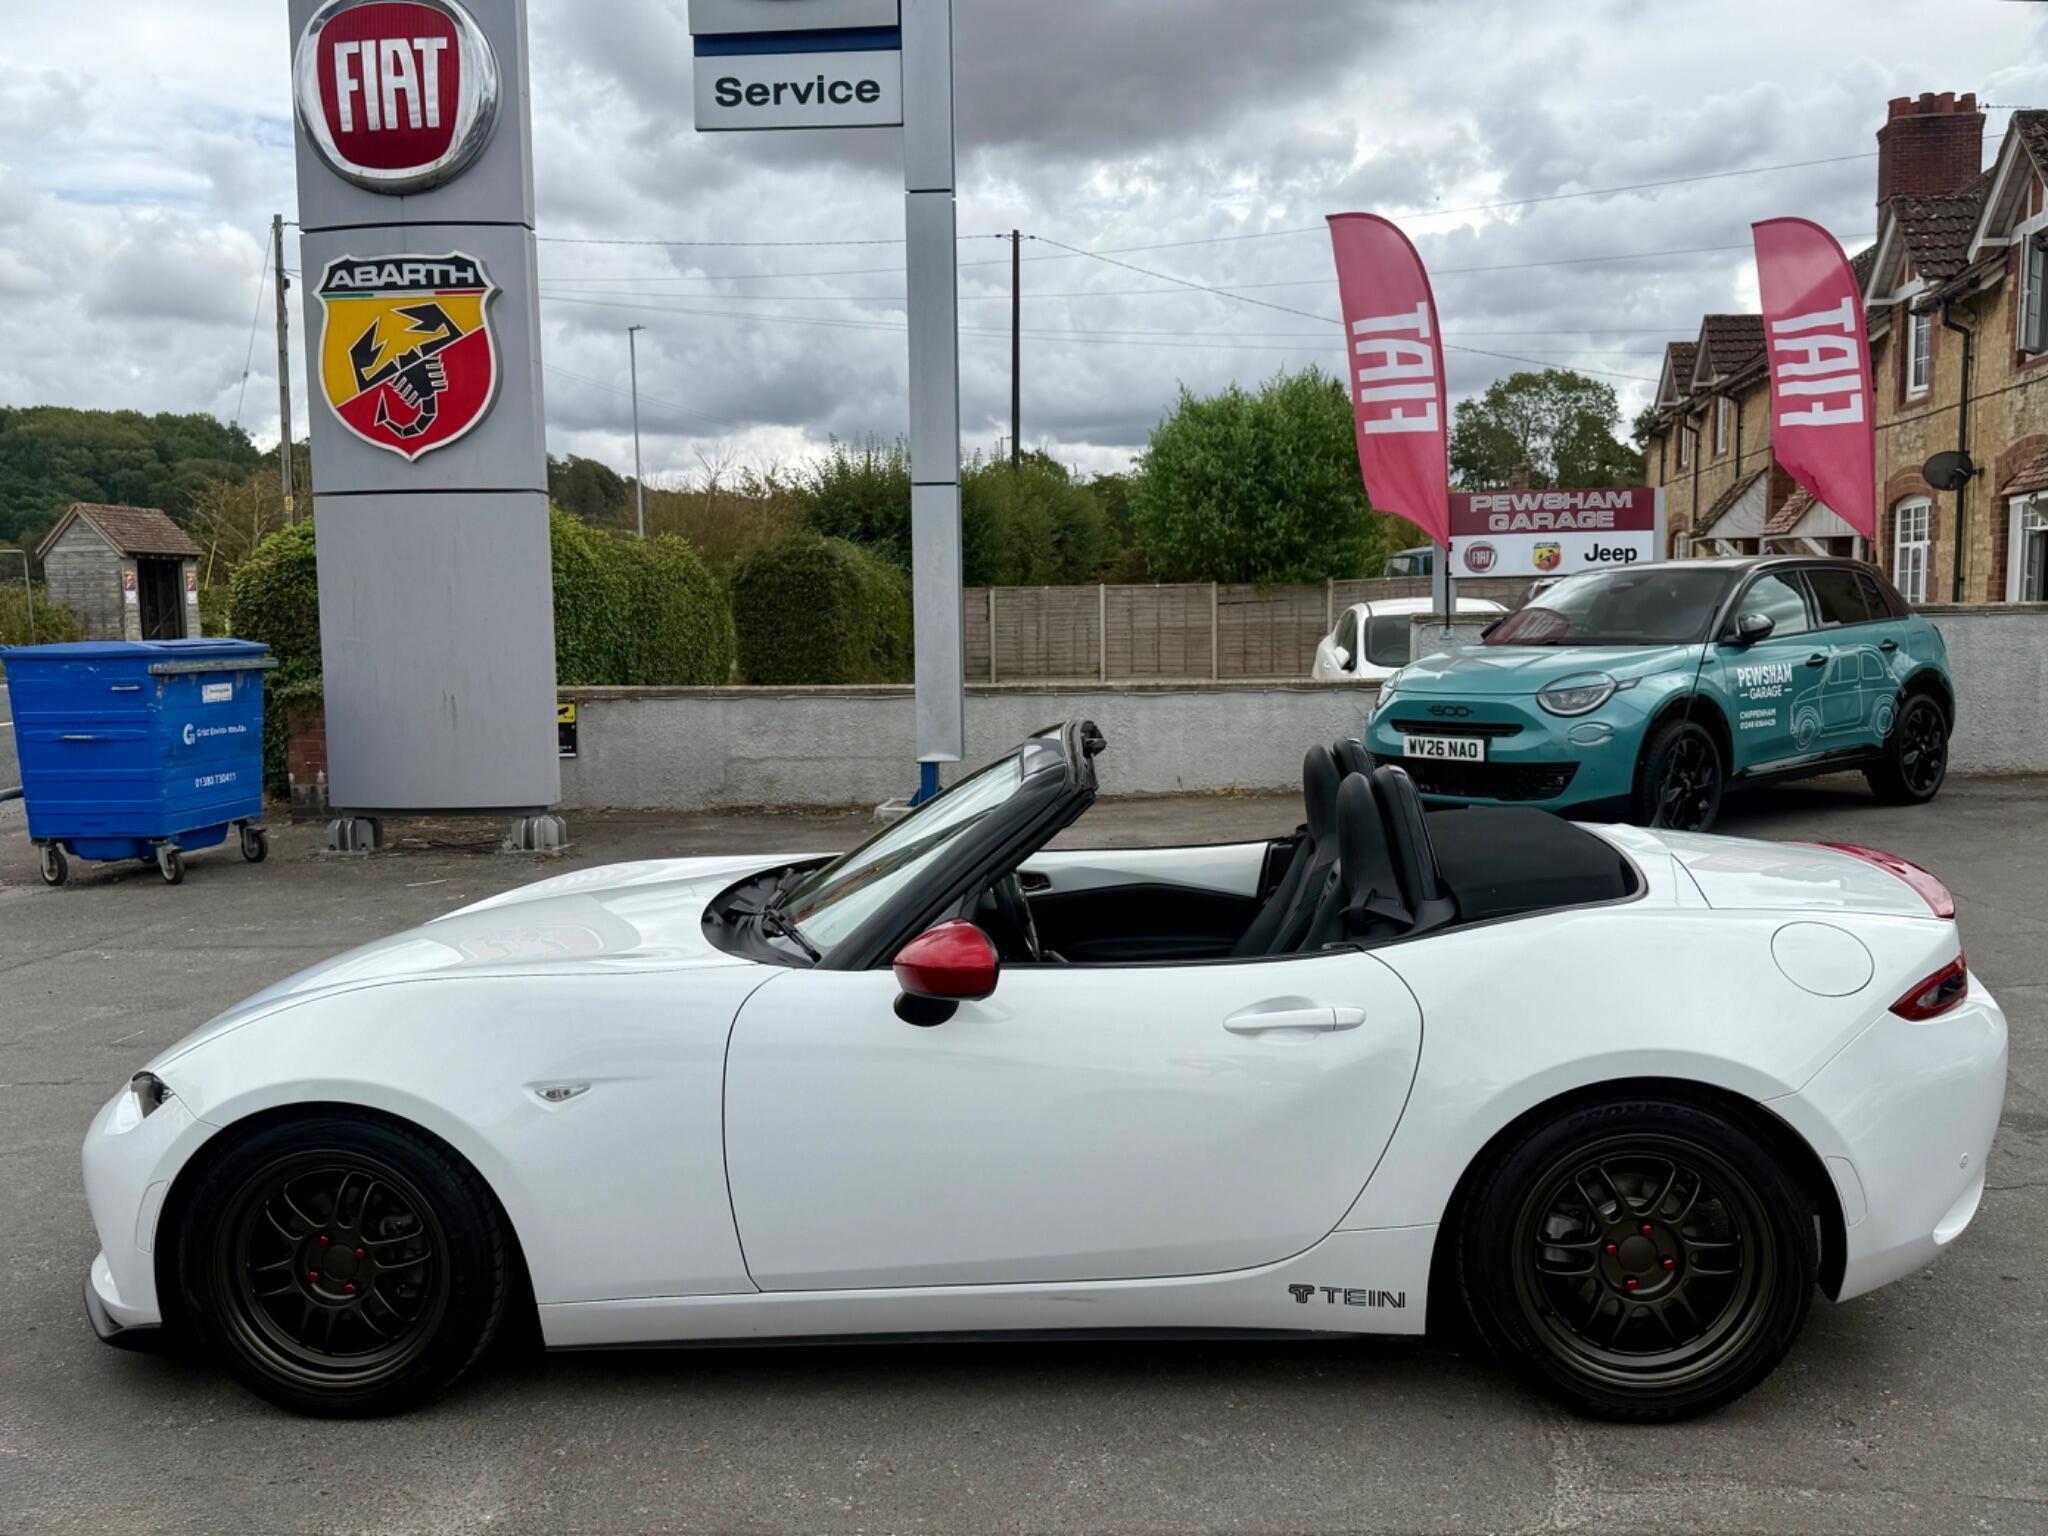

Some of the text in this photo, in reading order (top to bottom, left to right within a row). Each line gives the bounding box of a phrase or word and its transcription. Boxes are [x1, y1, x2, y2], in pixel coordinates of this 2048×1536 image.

[334, 37, 447, 132] FIAT
[715, 75, 880, 107] Service
[328, 263, 475, 288] ABARTH
[1470, 491, 1632, 513] PEWSHAM
[1489, 511, 1615, 532] GARAGE
[1472, 550, 1491, 567] FIAT
[1584, 543, 1637, 564] Jeep
[1737, 663, 1793, 688] PEWSHAM
[1749, 685, 1782, 700] GARAGE
[1409, 739, 1477, 758] WV26 NAO
[1319, 1286, 1405, 1308] TEIN
